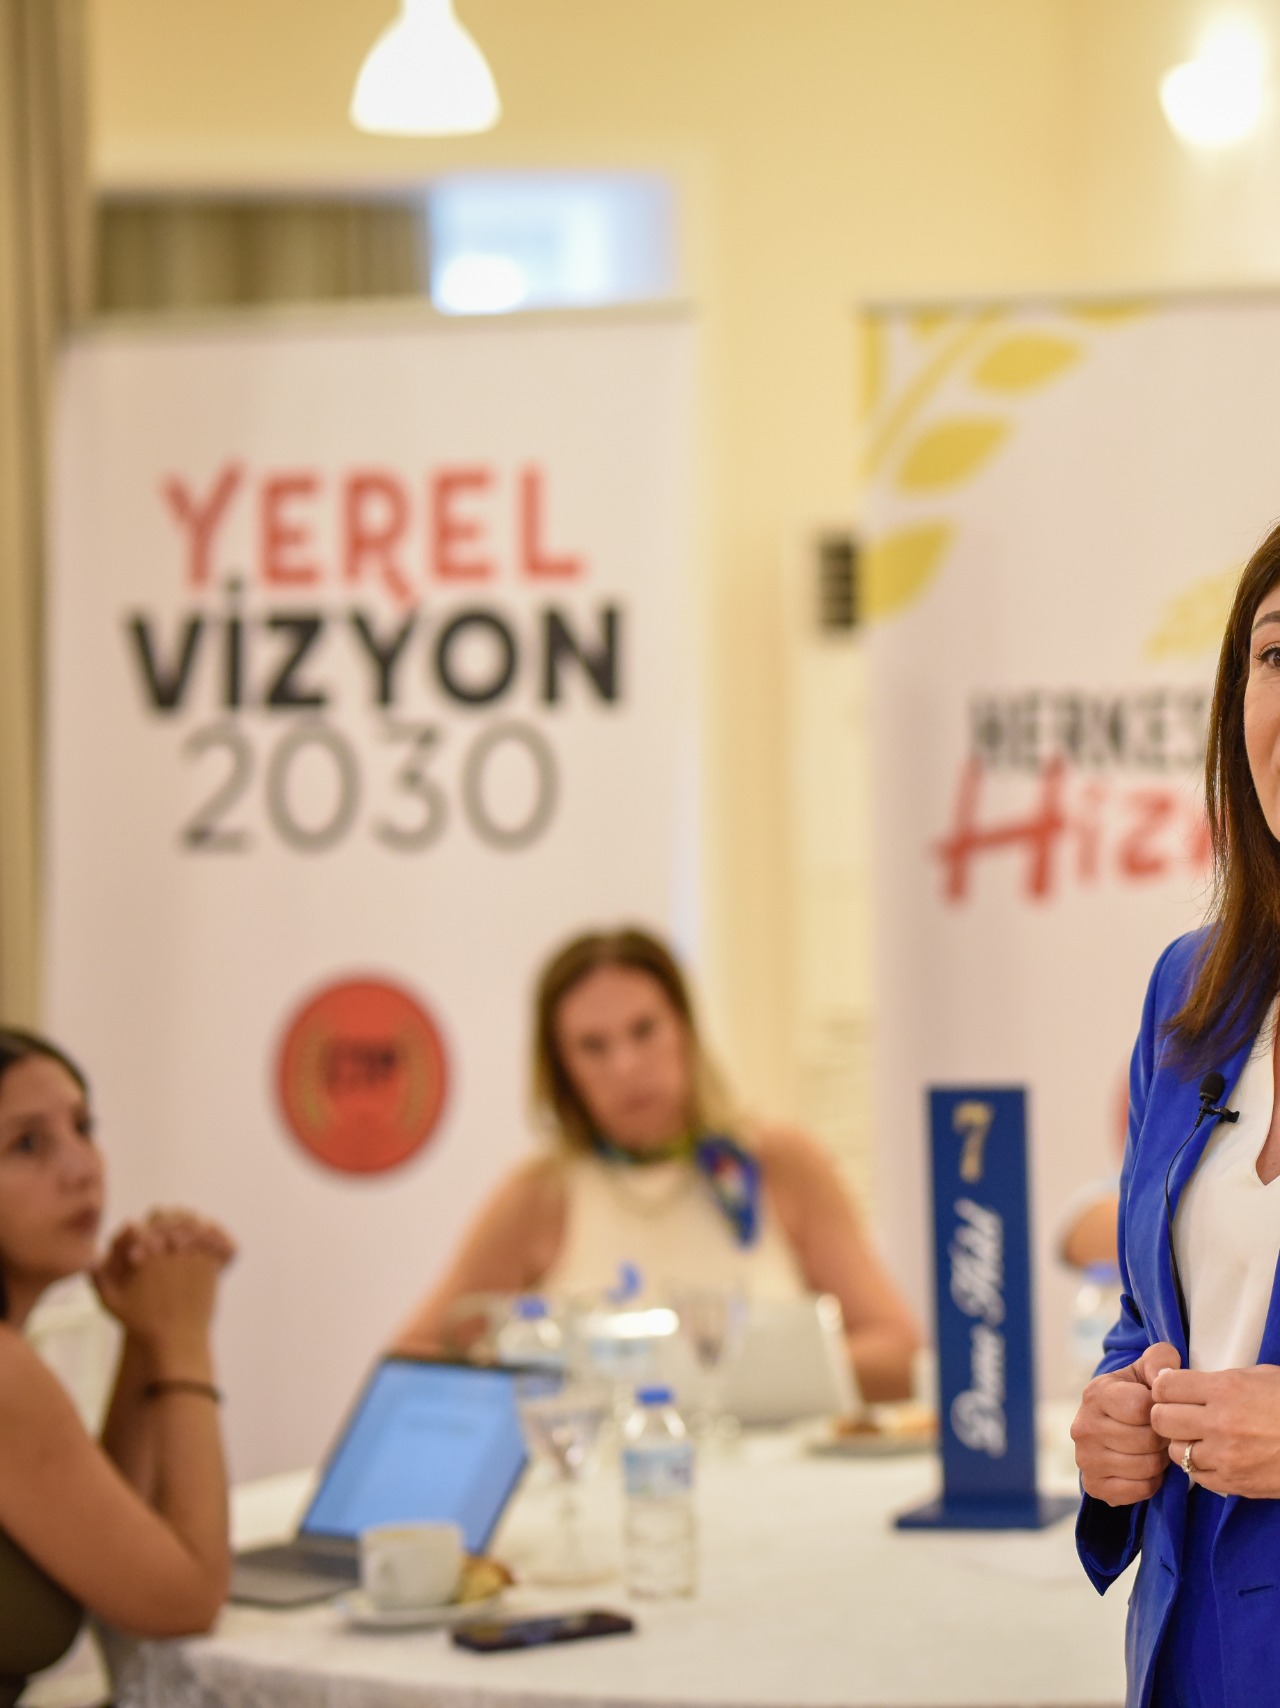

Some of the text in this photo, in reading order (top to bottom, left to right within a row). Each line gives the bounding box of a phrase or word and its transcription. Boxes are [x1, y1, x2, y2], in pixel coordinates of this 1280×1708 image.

[163, 461, 587, 607] YEREL
[128, 575, 624, 715] VİZYON
[180, 719, 559, 854] 2030
[951, 1102, 993, 1183] 7
